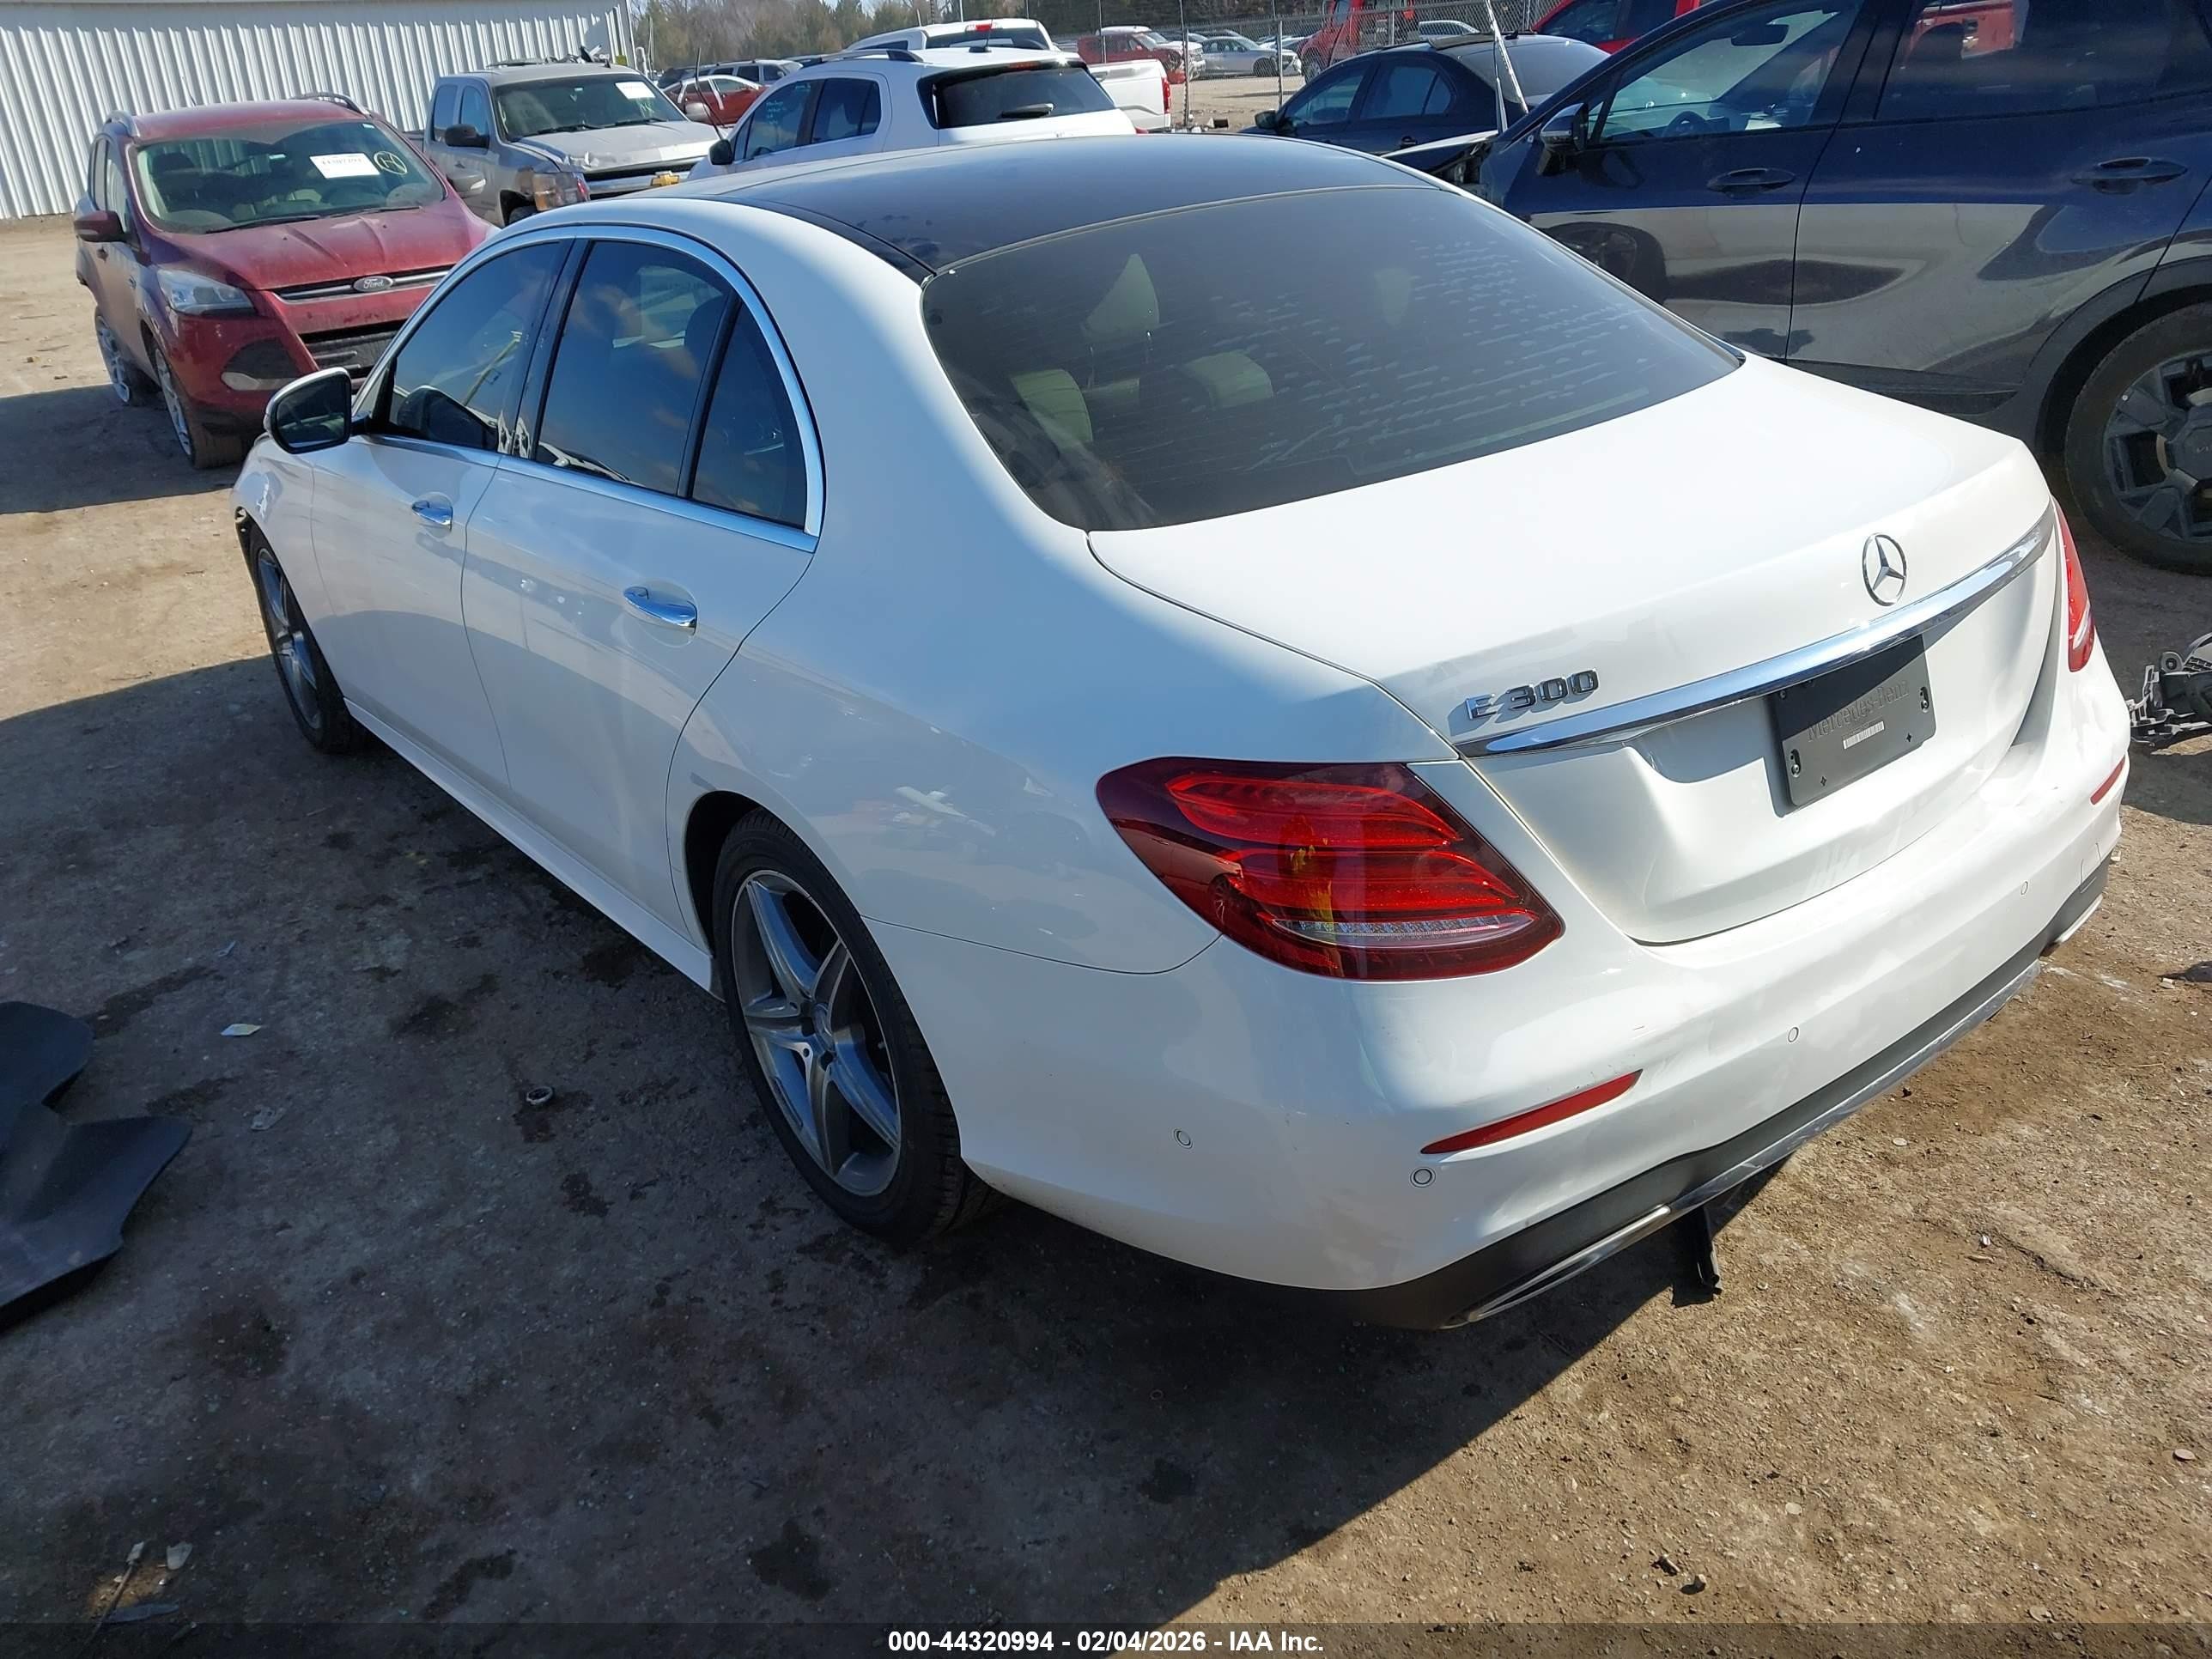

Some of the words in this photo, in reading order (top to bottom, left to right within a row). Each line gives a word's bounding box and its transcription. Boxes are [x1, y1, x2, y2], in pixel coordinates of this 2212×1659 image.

[1465, 693, 1498, 720] E
[1506, 668, 1601, 712] 300
[1807, 680, 1910, 743] Mercedes-Benz
